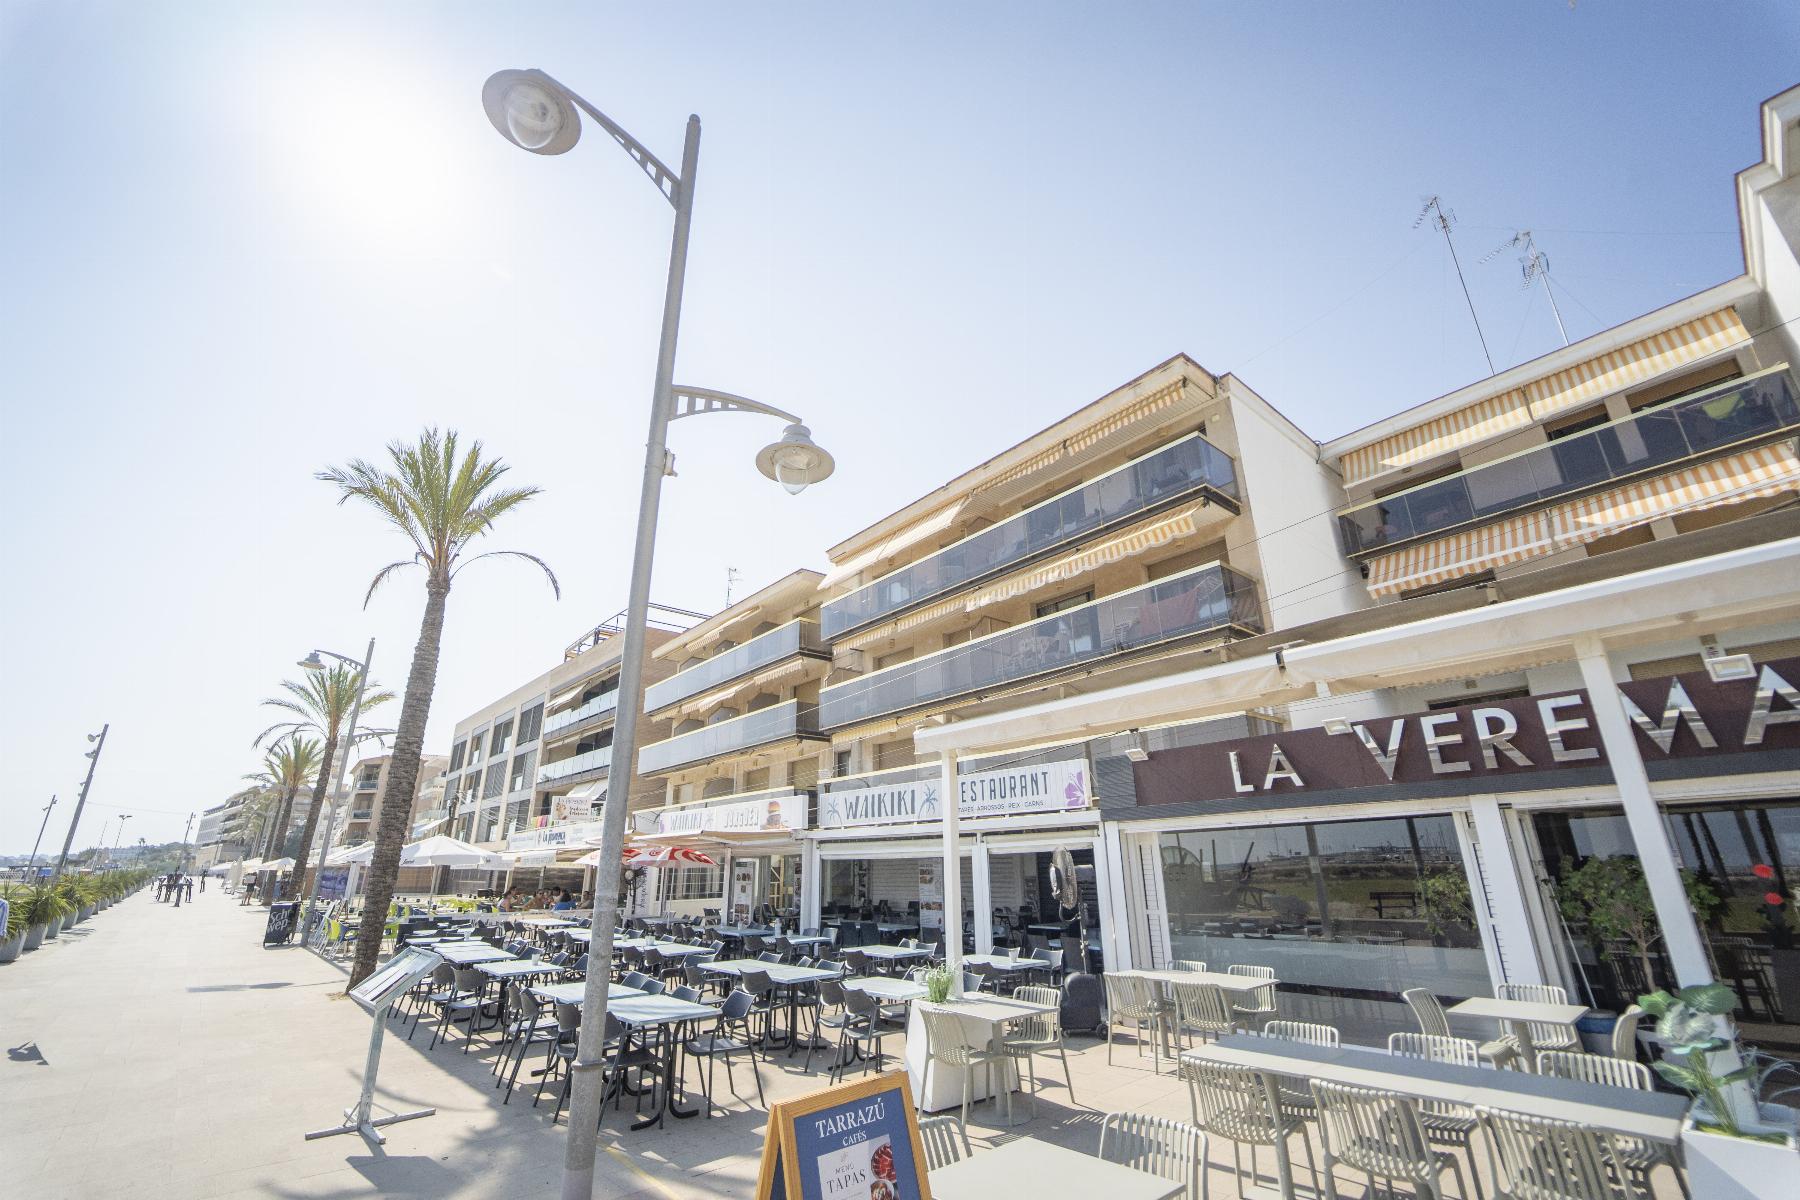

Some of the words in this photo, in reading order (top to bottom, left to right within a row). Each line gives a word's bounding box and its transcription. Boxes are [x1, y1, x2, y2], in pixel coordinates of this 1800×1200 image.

[1229, 743, 1304, 793] LA
[845, 789, 915, 820] WAIKIKI
[960, 771, 1049, 803] ESTAURANT
[815, 1097, 885, 1138] TARRAZÚ
[842, 1130, 867, 1146] CAFÉS
[826, 1168, 866, 1193] TAPAS
